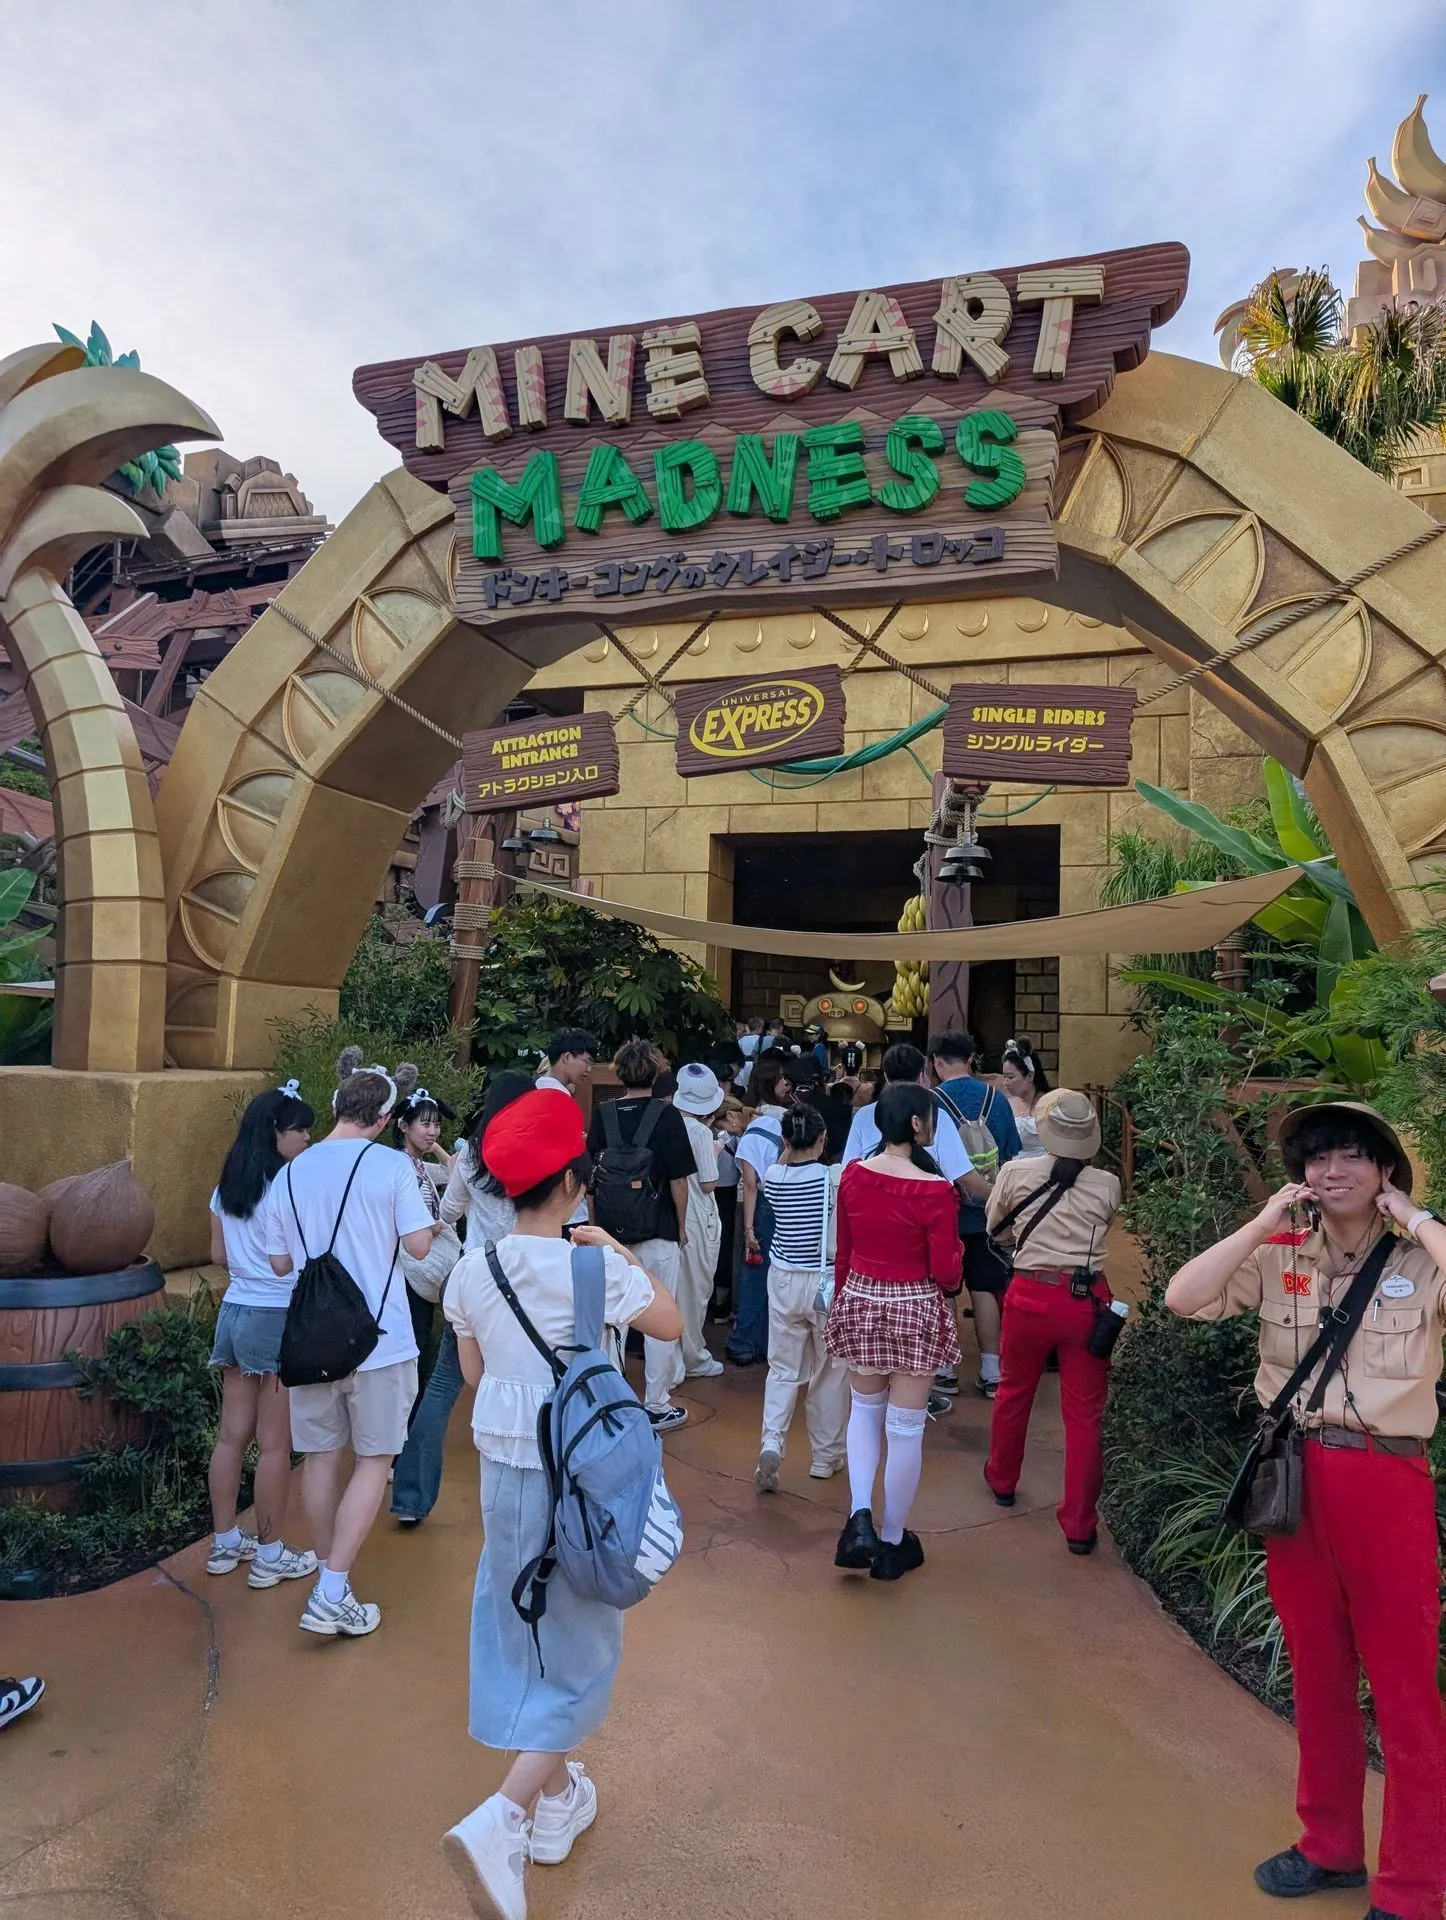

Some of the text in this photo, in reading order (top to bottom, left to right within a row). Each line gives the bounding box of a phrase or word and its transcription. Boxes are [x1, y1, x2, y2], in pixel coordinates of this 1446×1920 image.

[412, 264, 1105, 453] MINE CART
[469, 408, 1028, 560] MADNESS
[721, 688, 794, 706] UNIVERSAL
[702, 696, 812, 750] EXPRESS
[971, 707, 1107, 726] SINGLE RIDERS
[491, 725, 582, 755] ATTRACTION
[967, 734, 1104, 753] シングルライダー
[501, 744, 578, 769] ENTRANCE
[478, 765, 599, 798] アトラクション入口
[1281, 1271, 1312, 1296] DK
